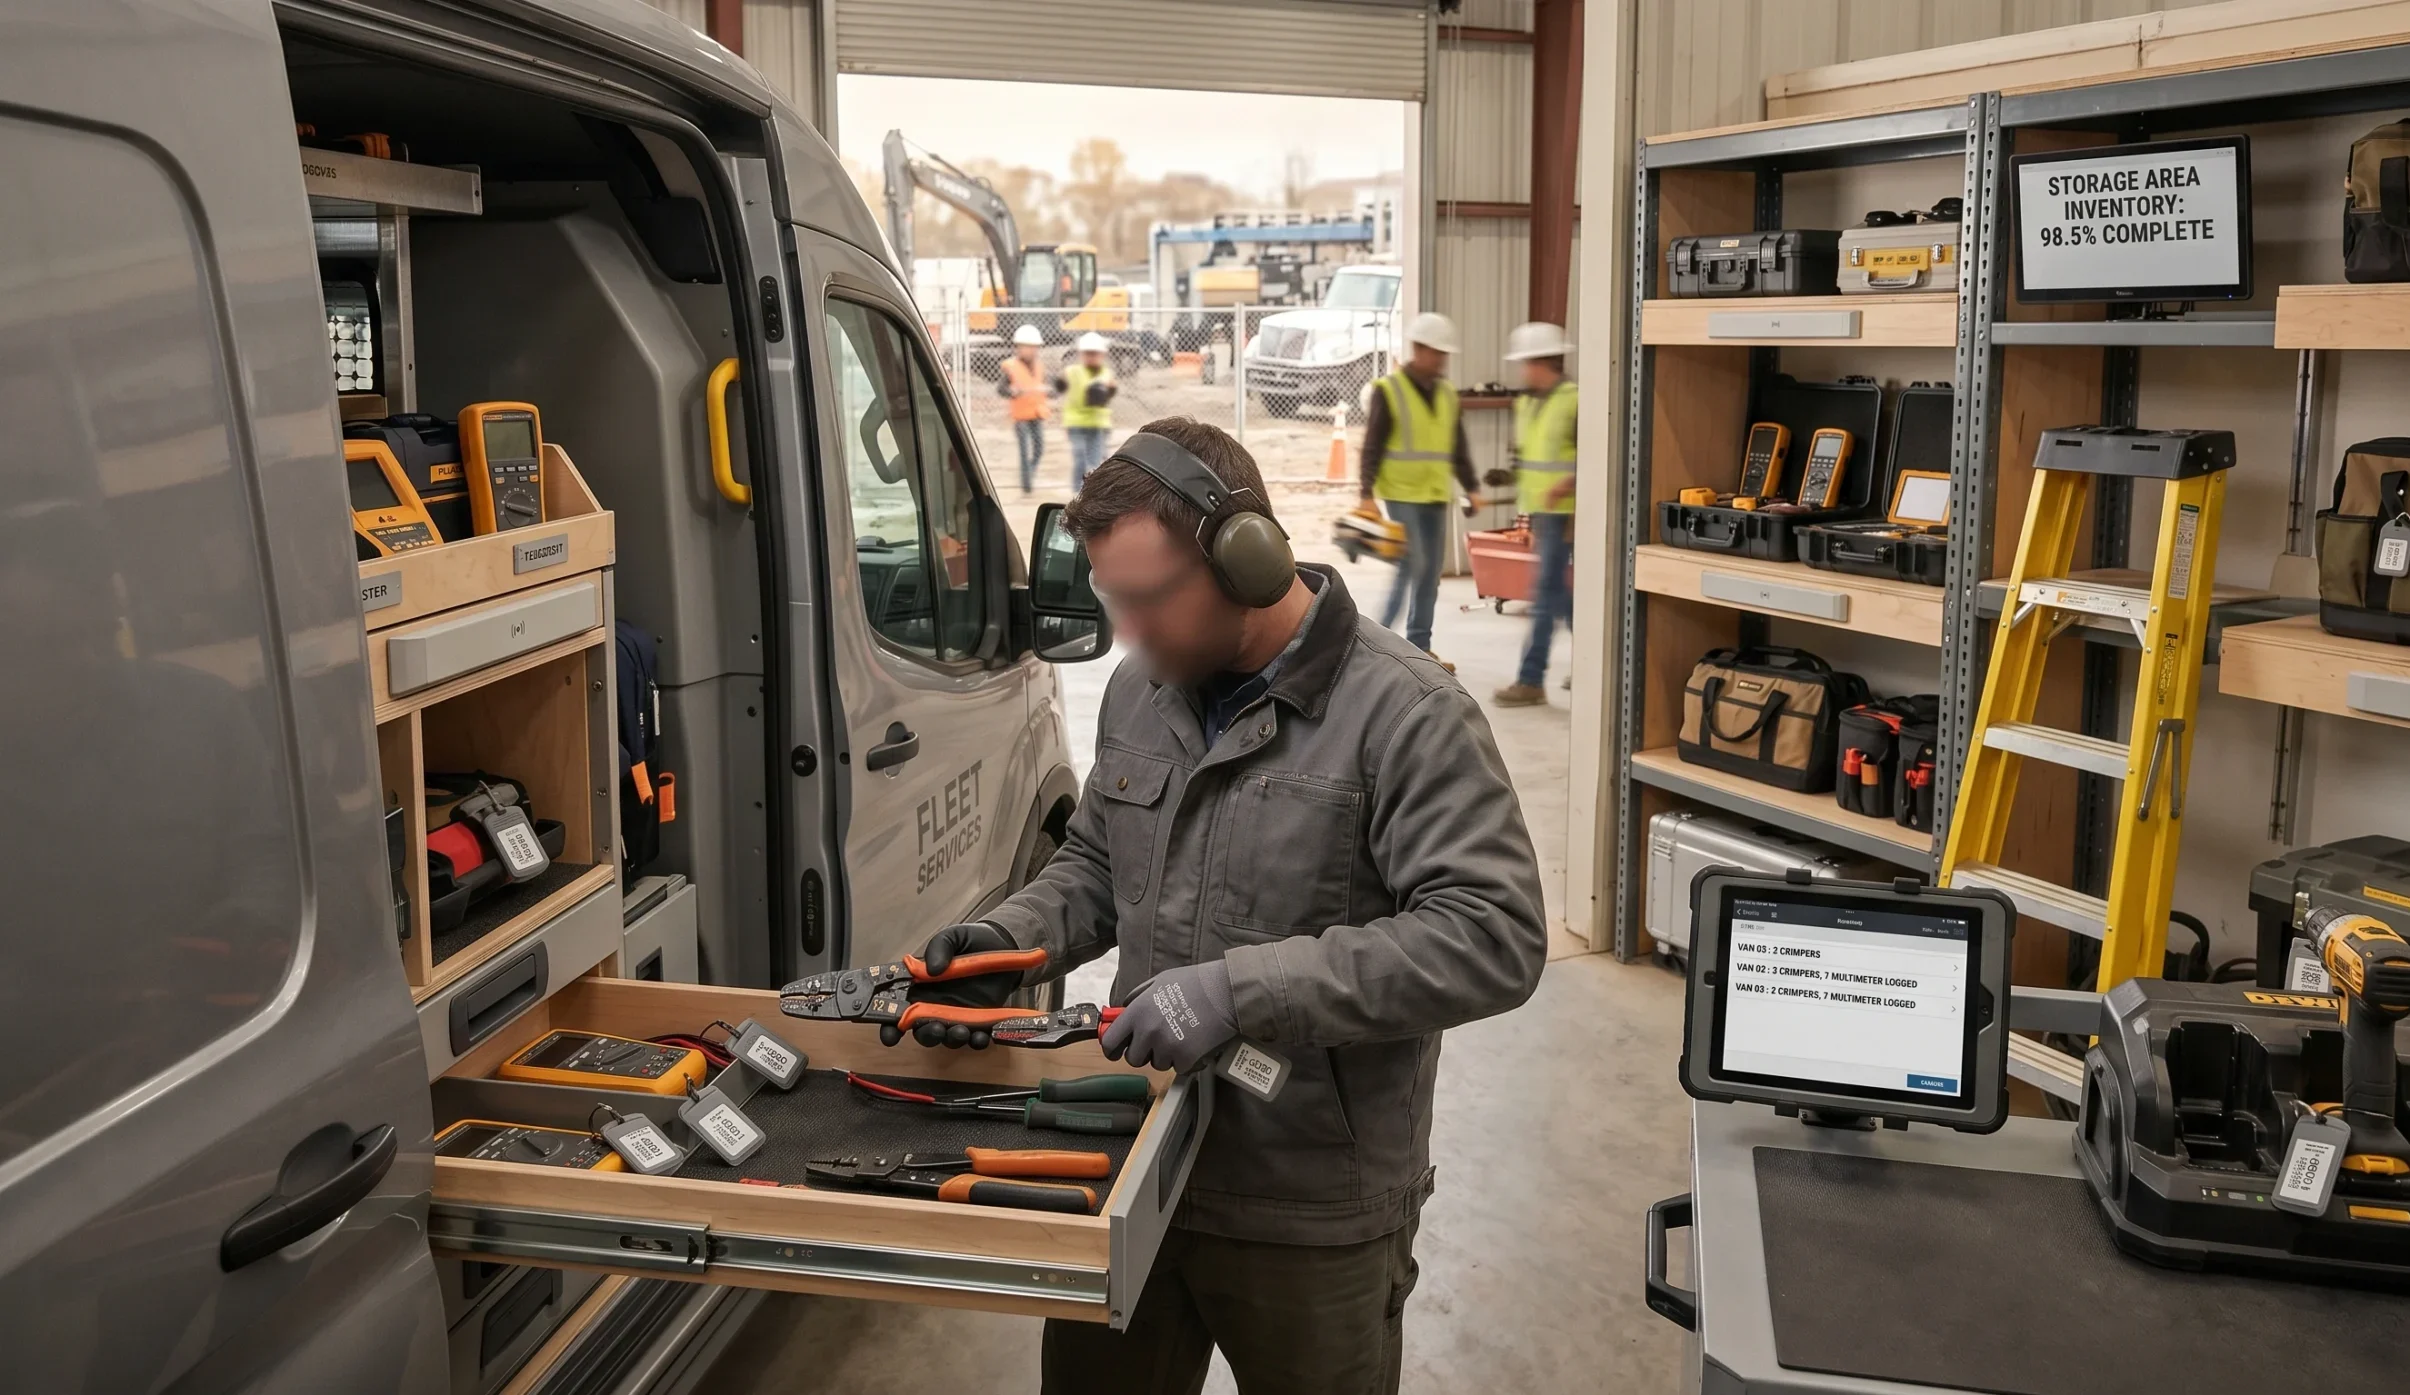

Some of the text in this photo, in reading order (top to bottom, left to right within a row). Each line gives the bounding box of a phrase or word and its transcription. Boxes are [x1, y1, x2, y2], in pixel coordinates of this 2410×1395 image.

[2048, 166, 2200, 196] STORAGE AREA
[2064, 194, 2184, 220] INVENTORY:
[2040, 219, 2214, 247] 98.5% COMPLETE
[916, 759, 983, 856] FLEET
[916, 814, 982, 895] SERVICES
[1738, 943, 1755, 953] VAN
[1756, 944, 1767, 954] 03
[1772, 946, 1778, 955] 2
[1779, 947, 1821, 959] CRIMPERS
[1737, 963, 1754, 973] VAN
[1755, 964, 1766, 974] 02
[1772, 966, 1778, 975] 3
[1779, 967, 1822, 980] CRIMPERS,
[1824, 971, 1829, 980] 7
[1831, 972, 1883, 986] MULTIMETER
[1885, 977, 1918, 989] LOGGED
[1735, 983, 1753, 993] VAN
[1754, 984, 1765, 994] 03
[1771, 986, 1777, 995] 2
[1778, 986, 1821, 1000] CRIMPERS,
[1823, 991, 1829, 1000] 7
[1830, 992, 1882, 1006] MULTIMETER
[1883, 998, 1916, 1009] LOGGED
